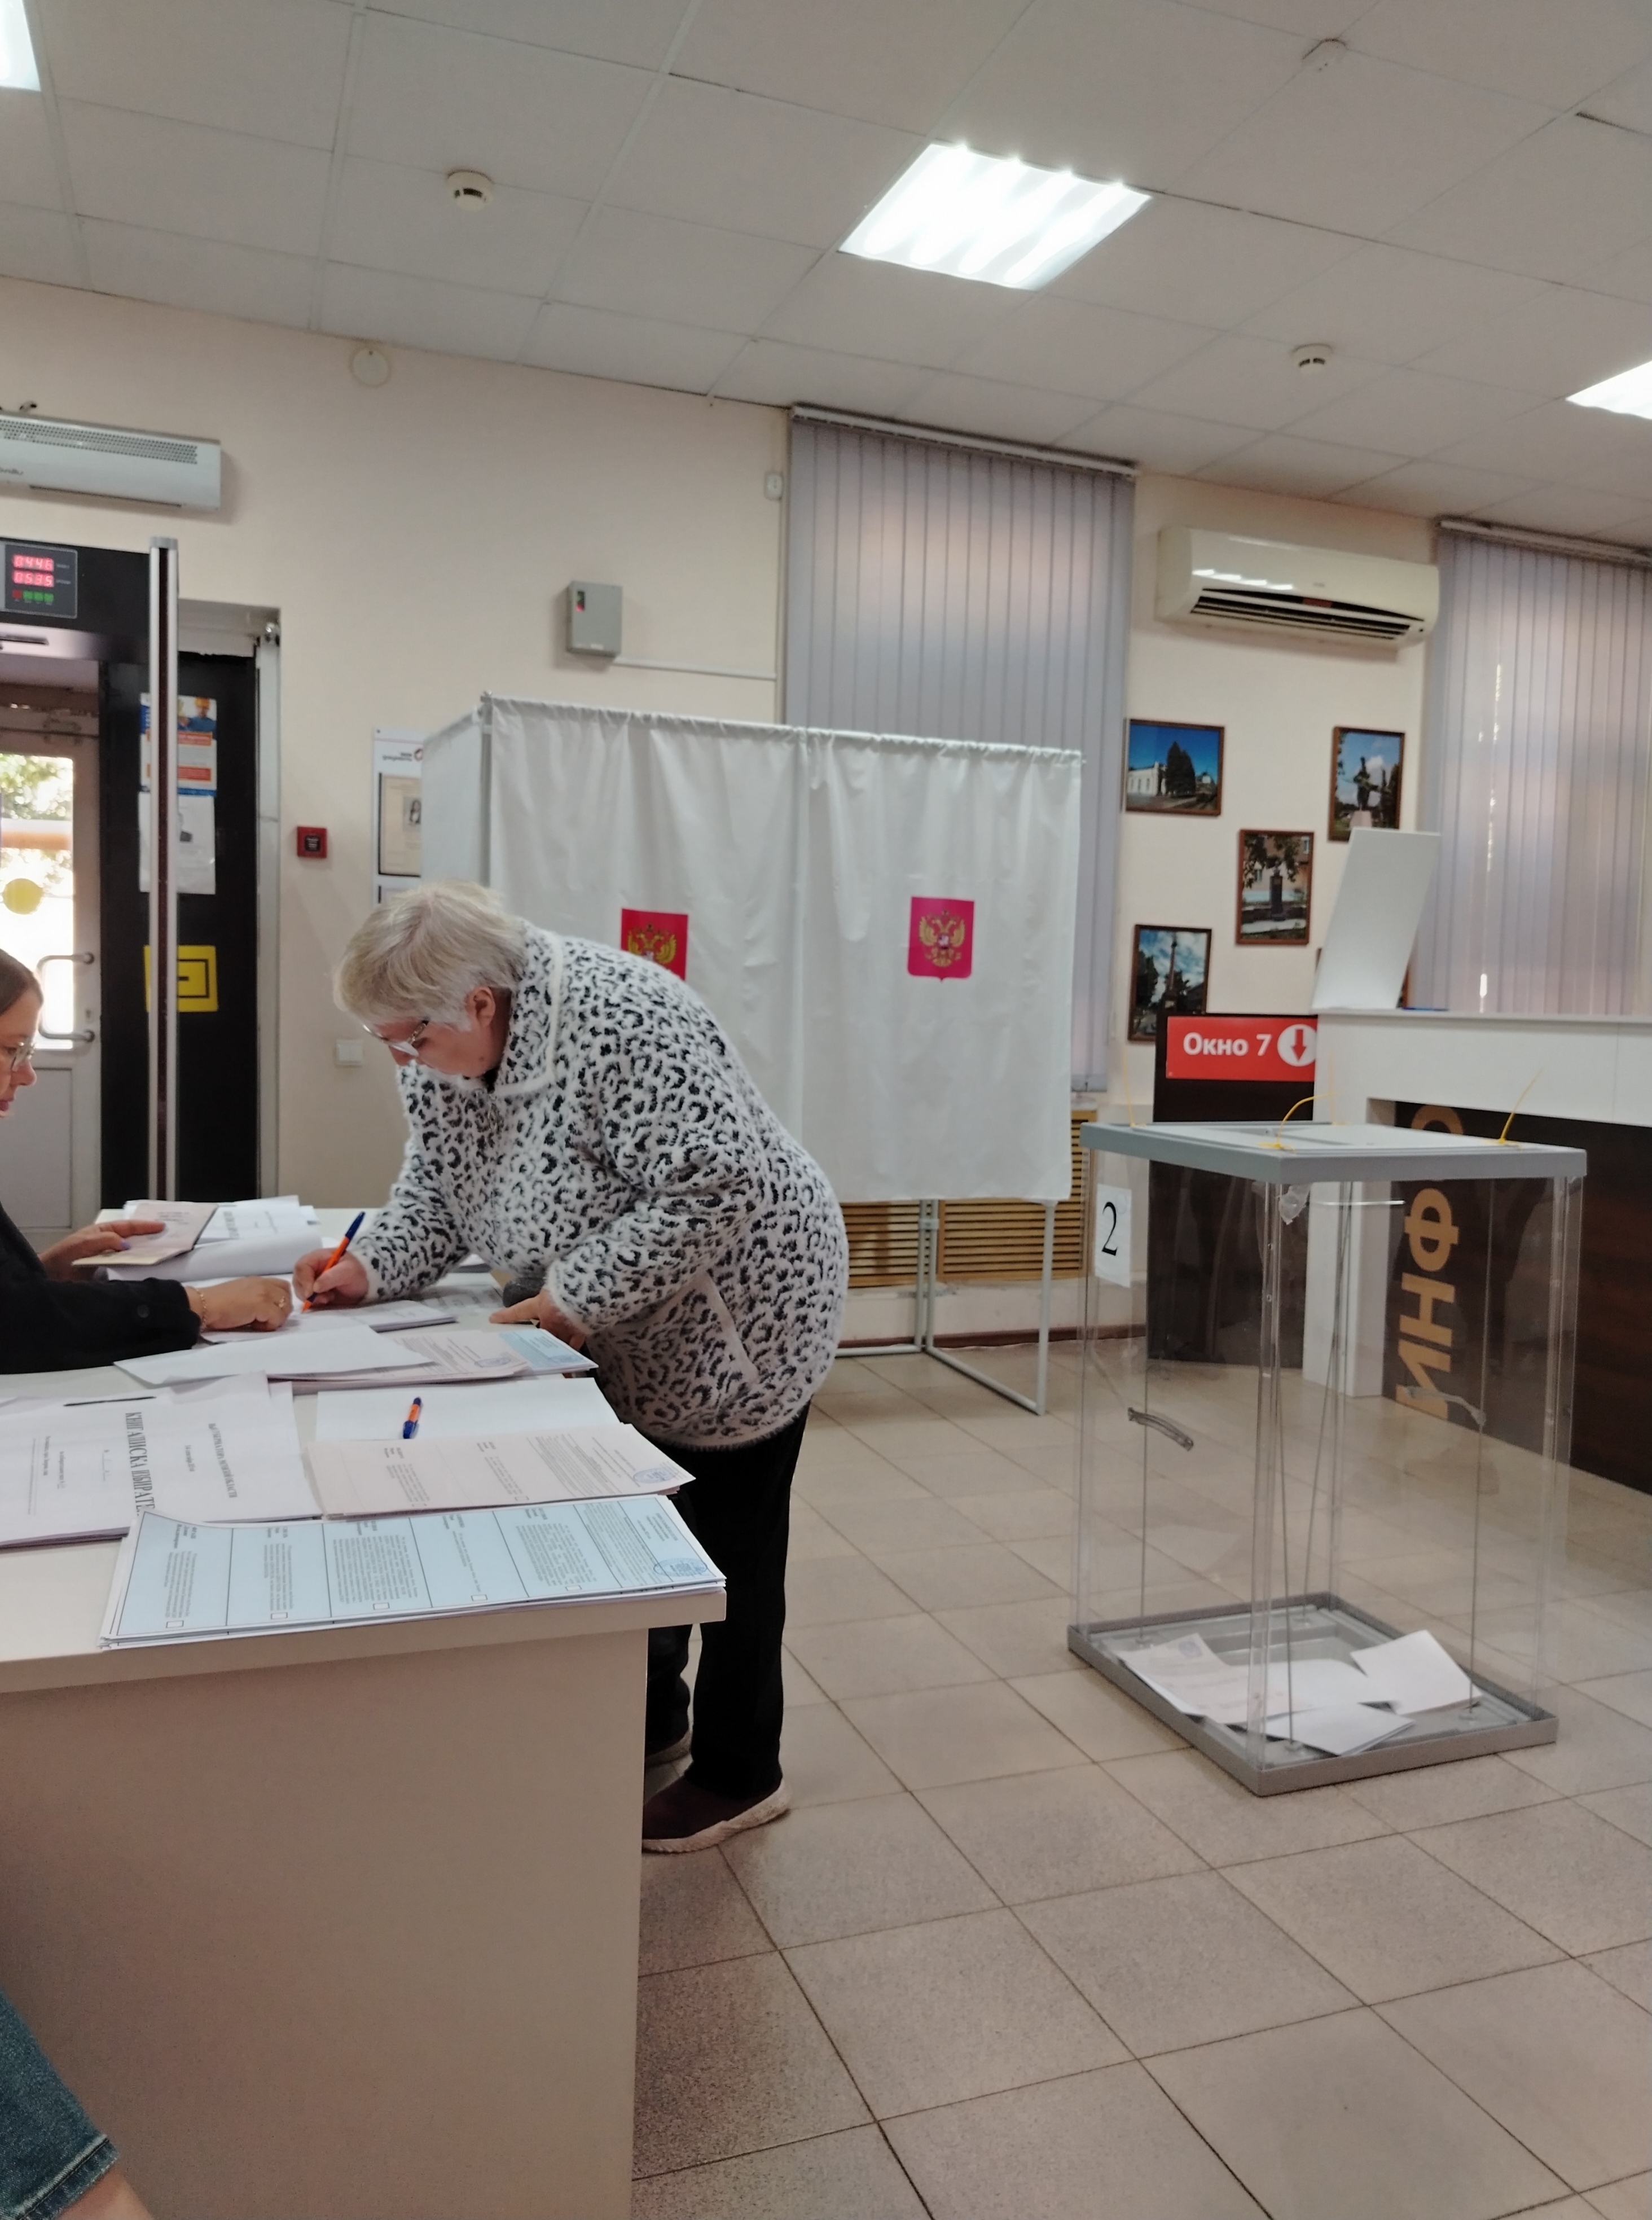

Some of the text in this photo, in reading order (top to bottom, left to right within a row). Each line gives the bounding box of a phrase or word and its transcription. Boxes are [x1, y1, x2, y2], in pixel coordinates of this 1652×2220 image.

[1183, 1032, 1272, 1056] Окно 7
[1102, 1201, 1118, 1256] 2
[131, 1469, 155, 1516] ИЗБИРАТЕ
